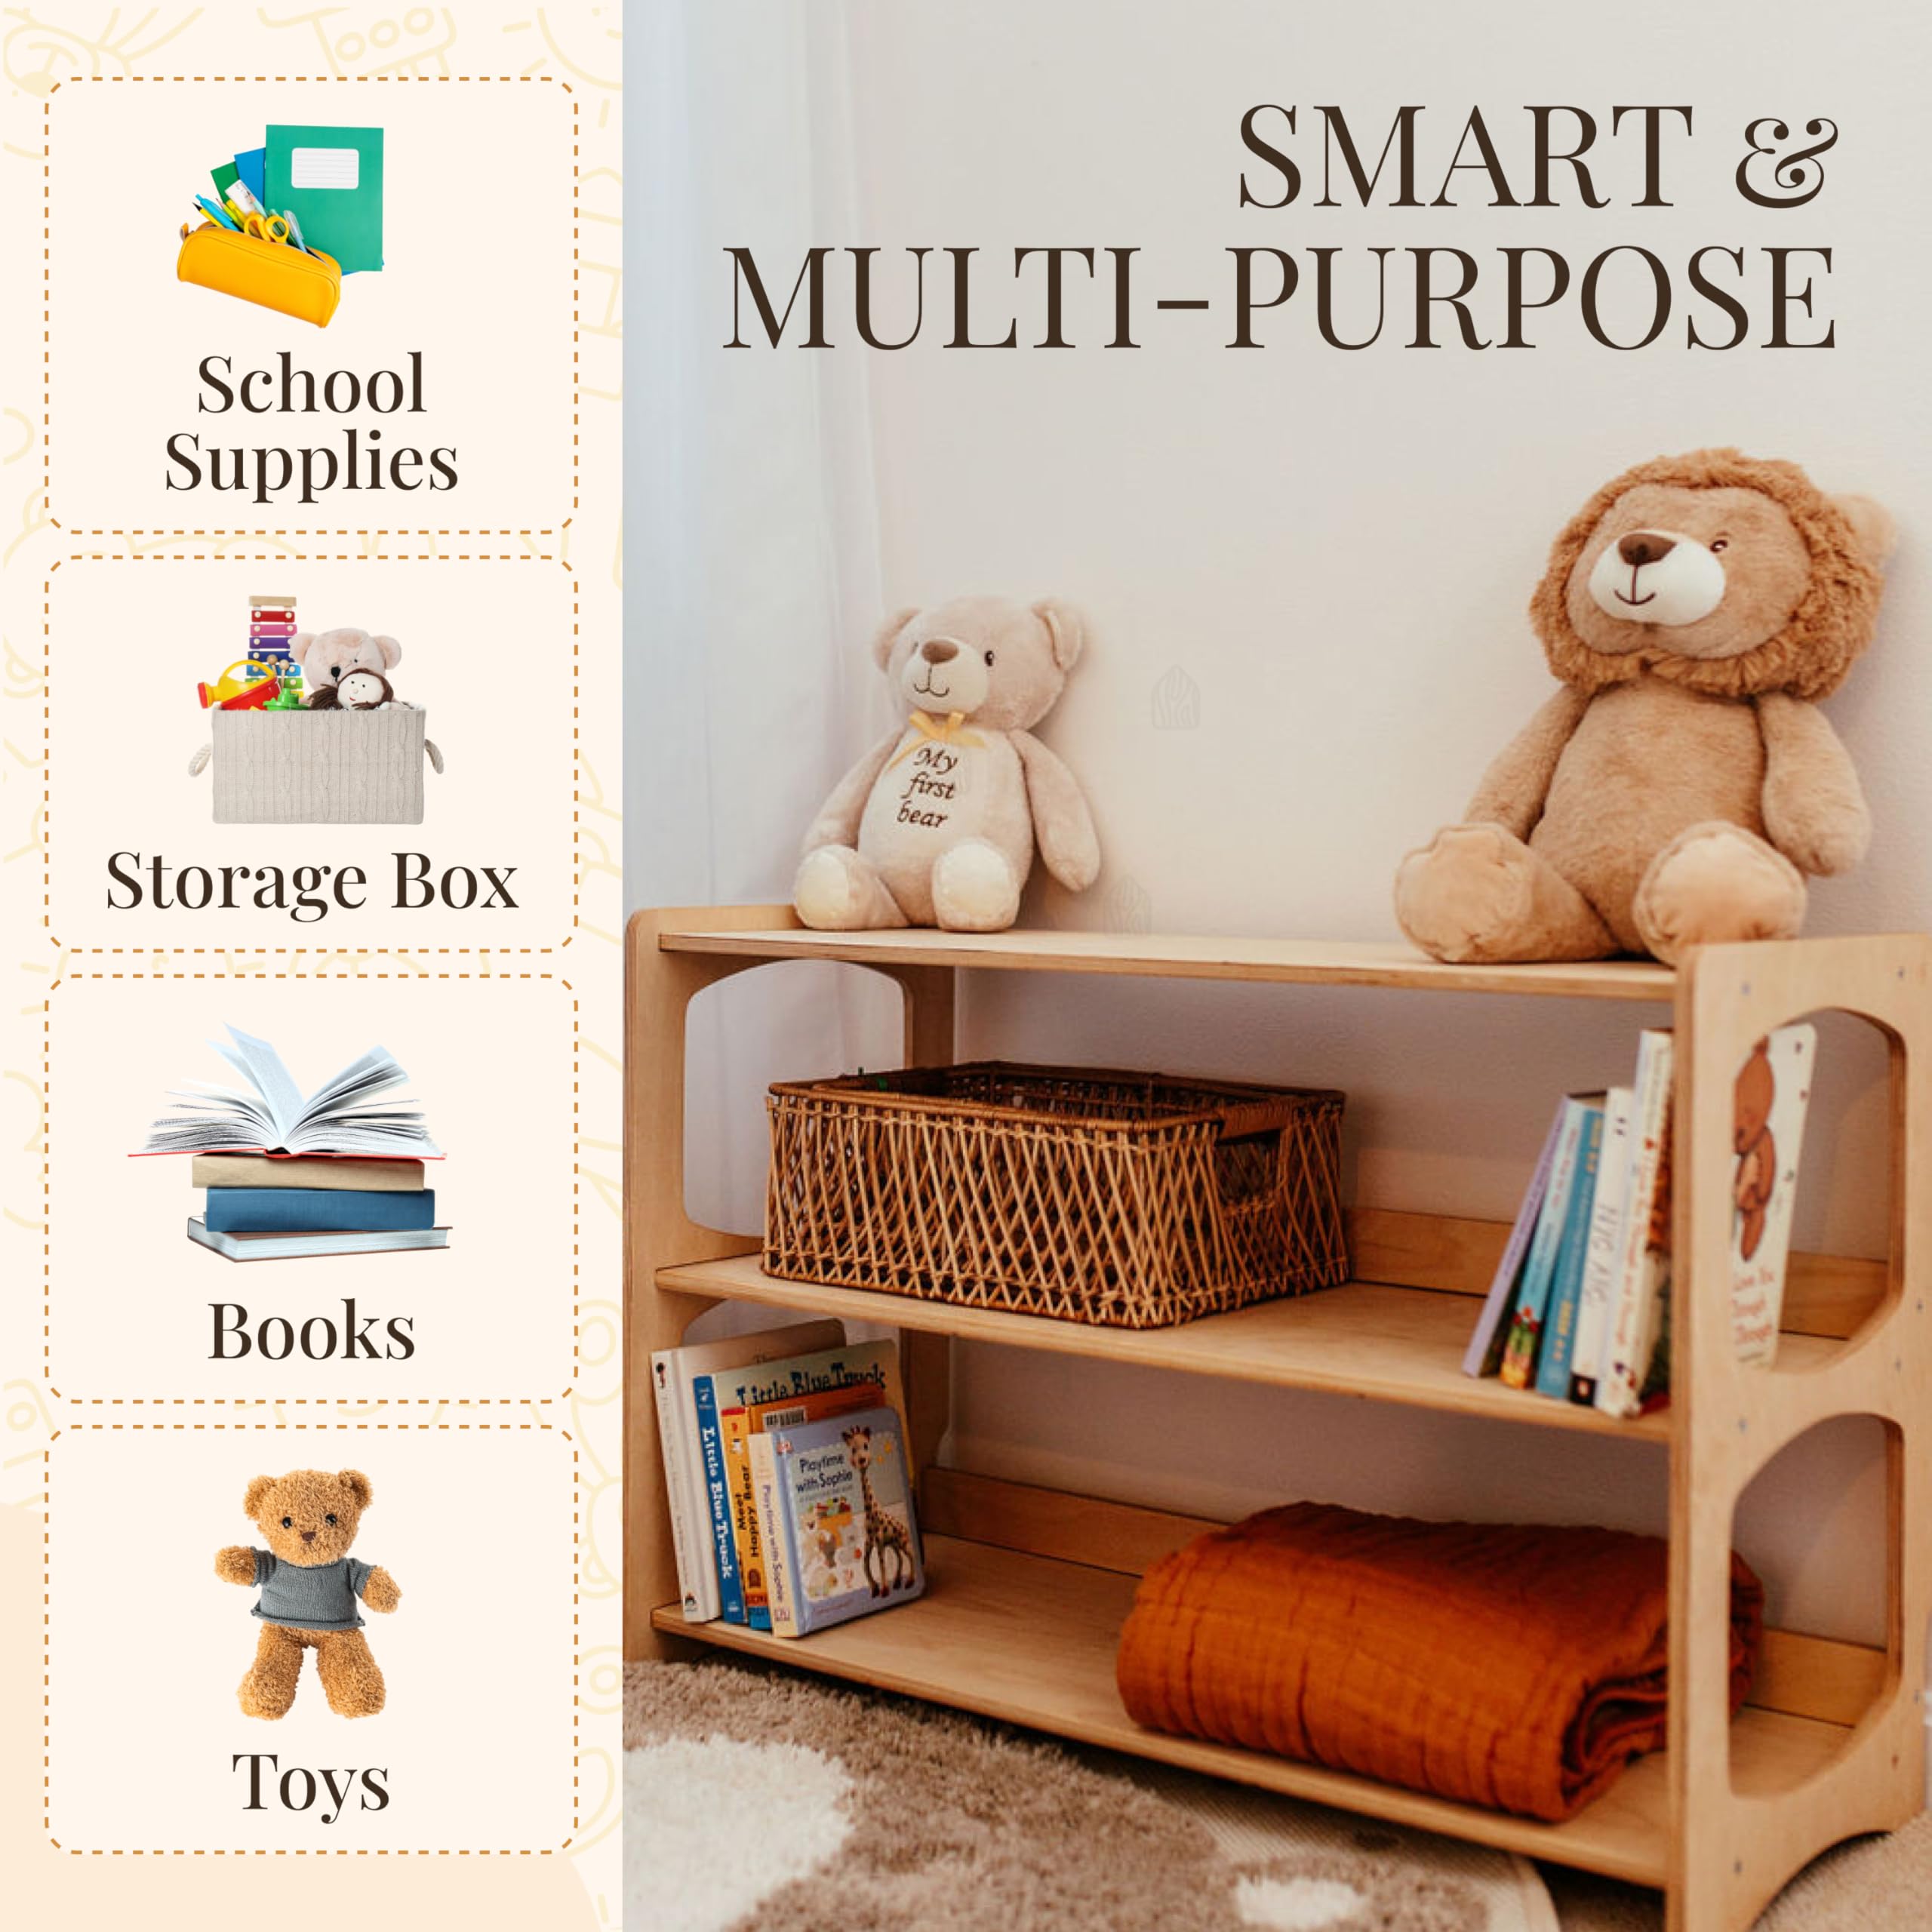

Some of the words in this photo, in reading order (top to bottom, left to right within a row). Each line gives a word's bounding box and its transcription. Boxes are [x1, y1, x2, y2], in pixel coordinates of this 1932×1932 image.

[913, 747, 958, 775] My
[900, 771, 955, 799] first
[897, 800, 949, 828] bear
